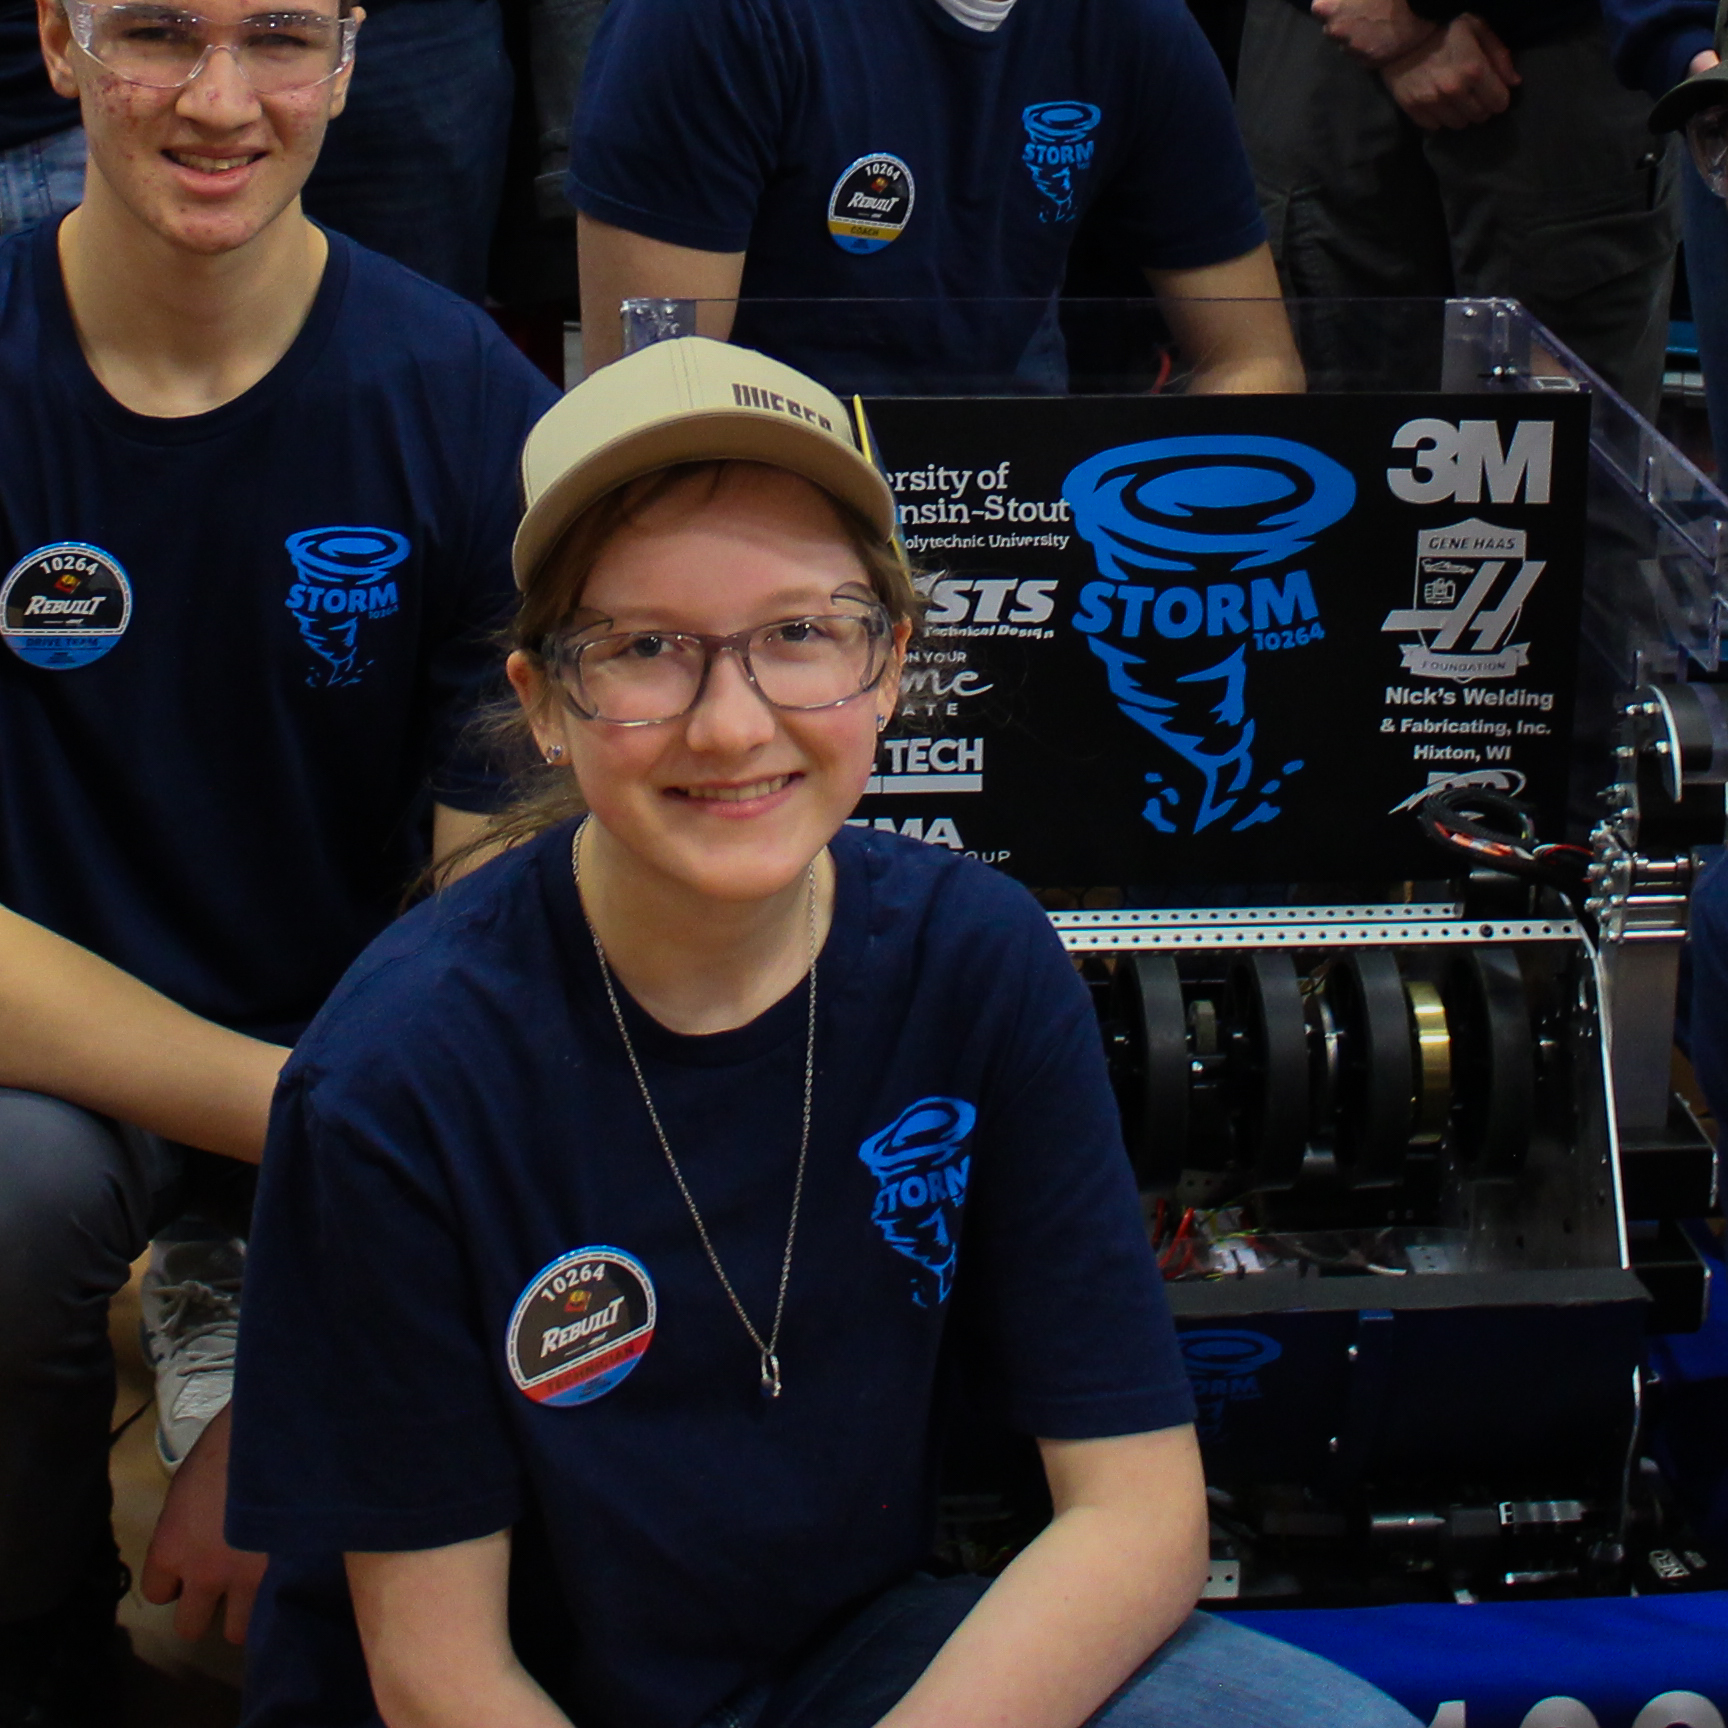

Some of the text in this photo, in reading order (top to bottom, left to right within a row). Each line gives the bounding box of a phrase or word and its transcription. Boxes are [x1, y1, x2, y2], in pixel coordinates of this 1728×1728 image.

[1022, 140, 1095, 167] STORM
[864, 162, 901, 182] 10264
[1386, 417, 1555, 505] 3M
[976, 461, 1011, 490] of
[899, 494, 1071, 525] nsin-Stout
[905, 532, 1070, 552] olytechnic University
[1428, 536, 1516, 550] GENE HAAS
[39, 555, 100, 576] 10264
[284, 581, 399, 615] STORM
[1071, 569, 1319, 640] STORM
[25, 637, 61, 648] DRIVE
[996, 624, 1055, 640] Design
[1251, 621, 1326, 651] 10264
[922, 650, 968, 664] YOUR
[1421, 658, 1507, 673] FOUNDATION
[901, 668, 994, 697] me
[901, 702, 959, 717] ATE
[1384, 685, 1555, 711] Nick's Welding
[1379, 717, 1552, 737] & Fabricating, Inc.
[883, 736, 985, 774] TECH
[1413, 744, 1512, 763] Hixton, WI
[954, 850, 1012, 864] OUP
[539, 1262, 607, 1302] 10264
[545, 1343, 635, 1394] TECHNICIAN
